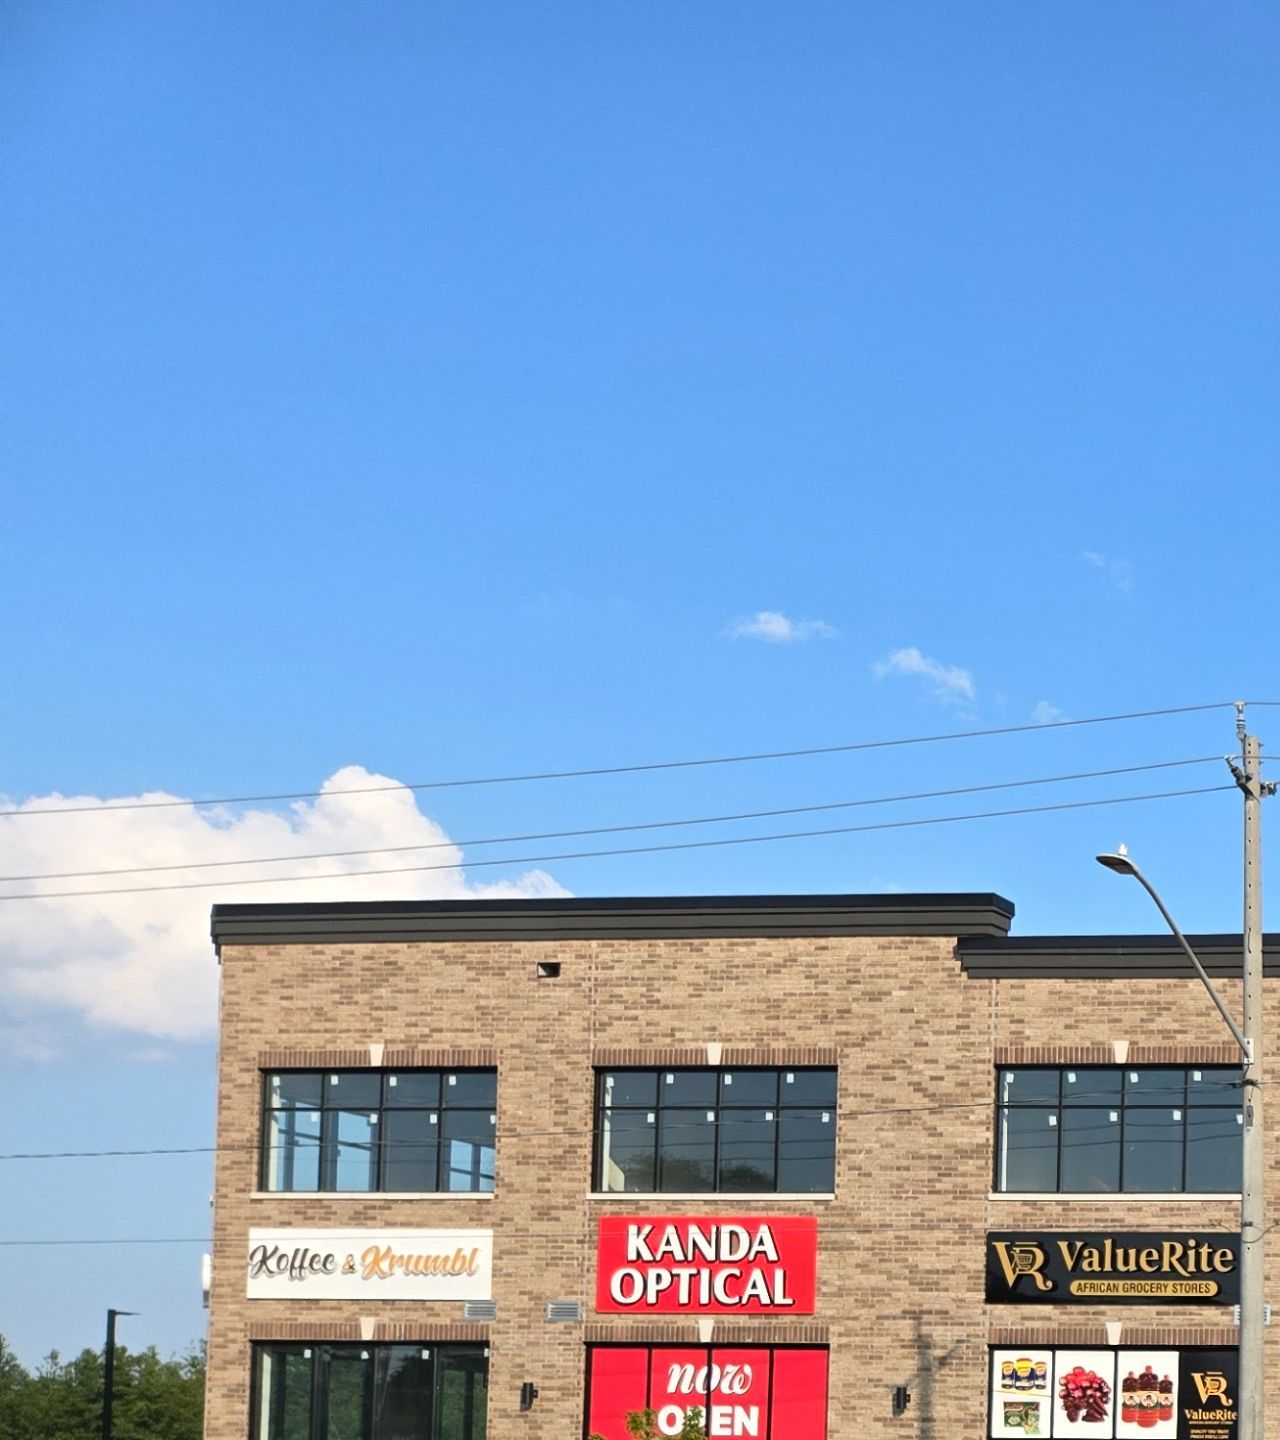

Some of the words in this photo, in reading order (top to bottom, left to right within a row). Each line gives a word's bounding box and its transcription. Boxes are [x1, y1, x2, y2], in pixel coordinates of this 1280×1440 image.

[627, 1224, 779, 1262] KANDA
[1057, 1238, 1234, 1277] ValueRite
[249, 1244, 336, 1280] Koffee
[342, 1254, 356, 1274] &
[360, 1245, 480, 1280] Krumbl
[610, 1267, 795, 1305] OPTICAL
[1076, 1282, 1119, 1294] AFRICAN
[1122, 1282, 1169, 1294] GROCERY
[1171, 1283, 1211, 1294] STORES
[1184, 1408, 1238, 1420] ValueRite
